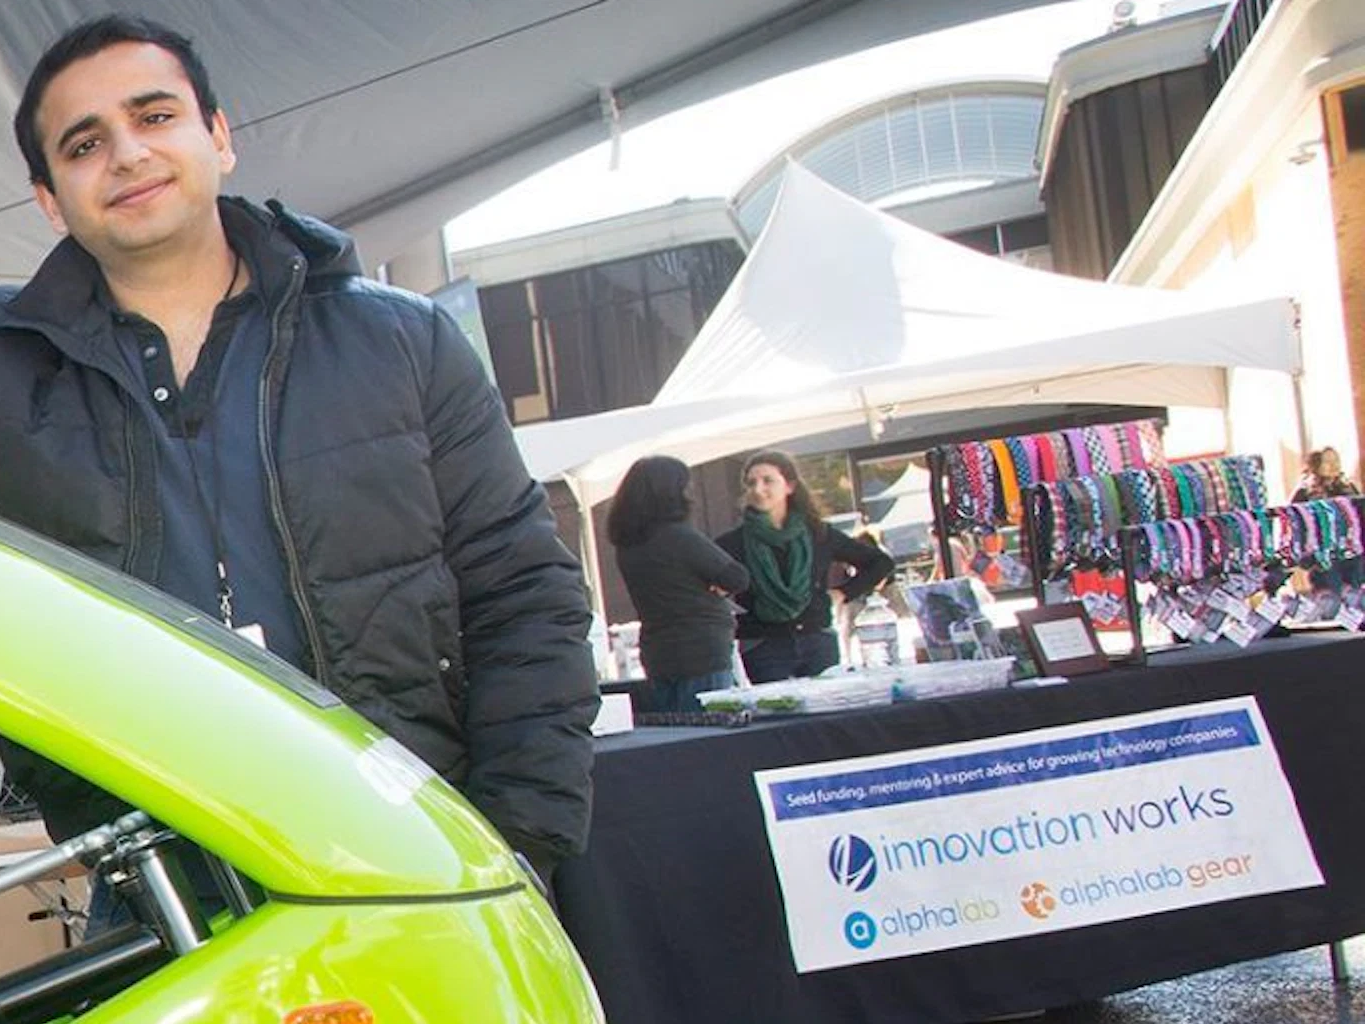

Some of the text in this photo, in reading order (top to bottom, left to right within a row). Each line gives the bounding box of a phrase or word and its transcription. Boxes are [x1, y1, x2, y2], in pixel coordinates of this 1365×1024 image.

[786, 726, 1238, 807] Seed funding, mentoring & expert advice for growing technology companies
[879, 785, 1235, 872] innovation works
[881, 895, 1001, 937] alphalab
[1060, 863, 1183, 906] alphalab
[1186, 853, 1253, 889] gear
